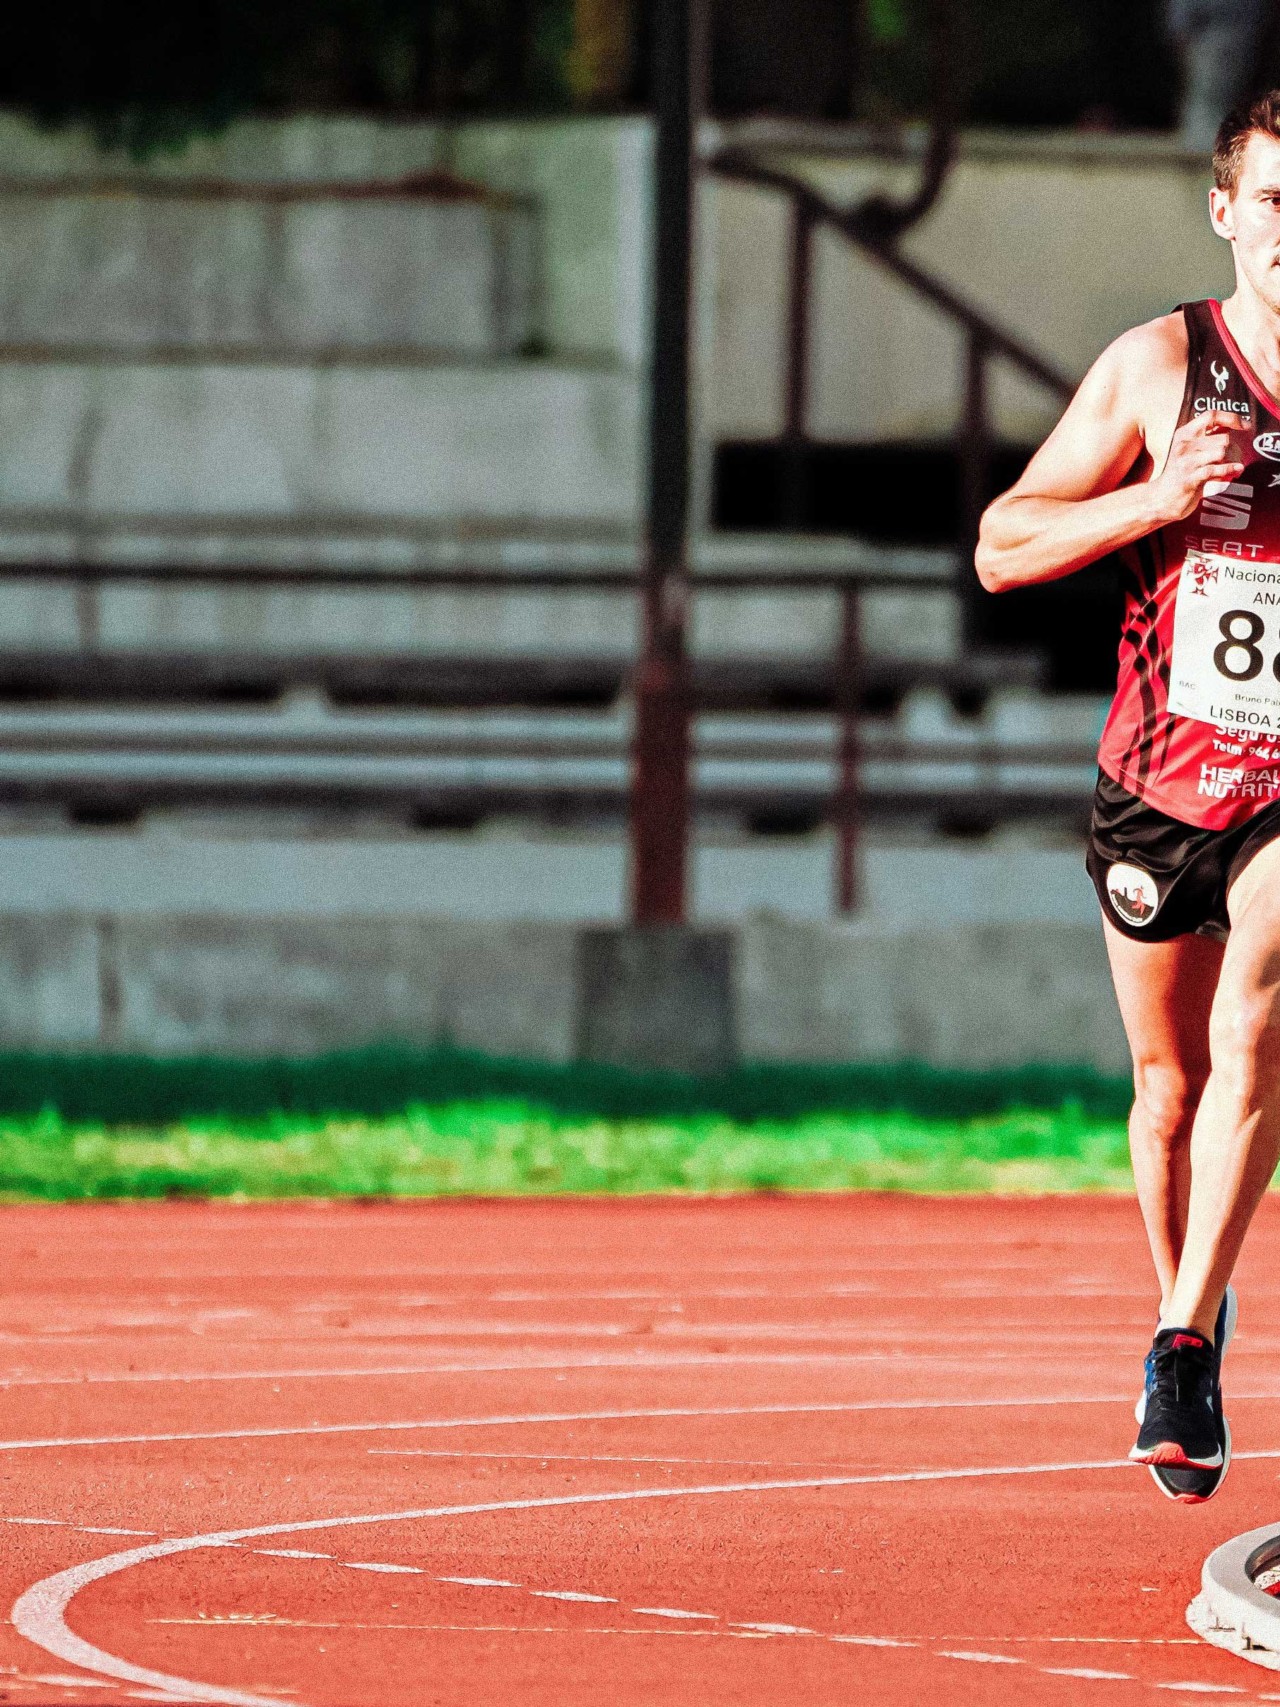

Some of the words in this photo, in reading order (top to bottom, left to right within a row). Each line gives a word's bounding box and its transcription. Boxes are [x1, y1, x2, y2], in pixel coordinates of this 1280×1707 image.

[1185, 535, 1264, 558] SEAT
[1235, 694, 1262, 703] Bruno
[1210, 705, 1271, 727] LISBOA
